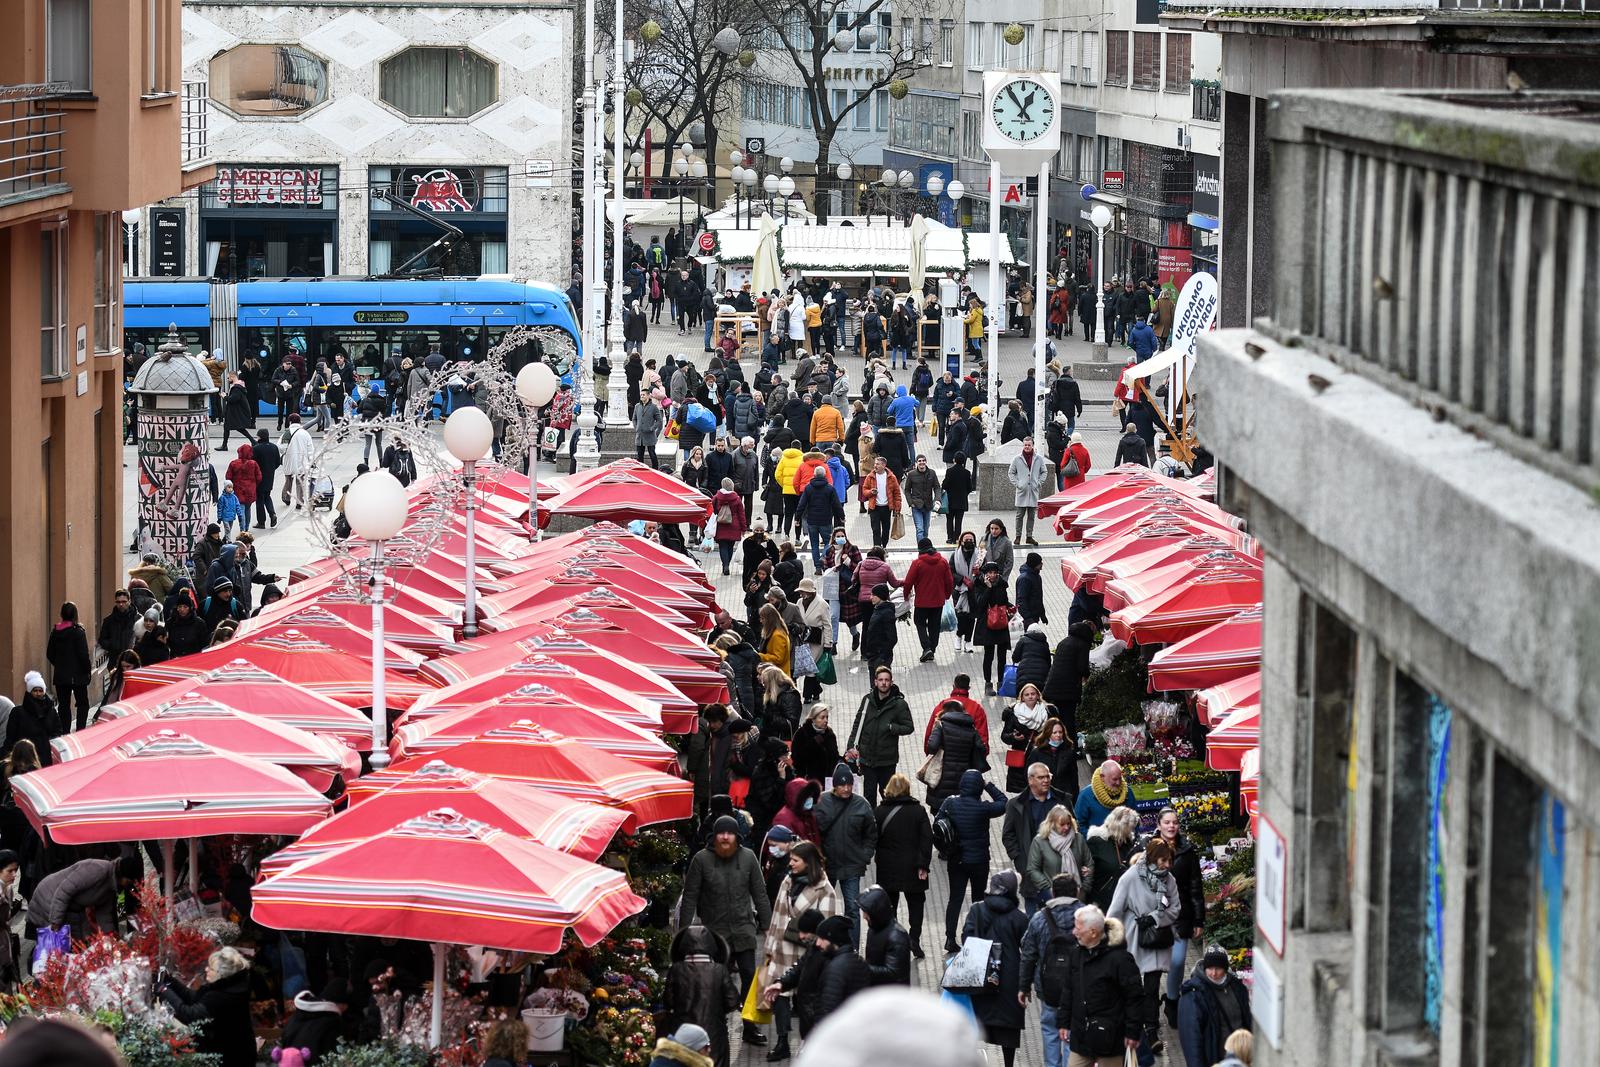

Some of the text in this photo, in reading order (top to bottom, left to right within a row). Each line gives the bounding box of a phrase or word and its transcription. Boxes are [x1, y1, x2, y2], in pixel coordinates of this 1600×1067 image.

[219, 170, 319, 186] AMERICAN
[219, 187, 321, 202] STEAK & GRILL
[1004, 182, 1024, 203] A1
[356, 312, 365, 322] 12
[1175, 280, 1203, 340] UKIDAMO
[1186, 298, 1205, 338] COVID
